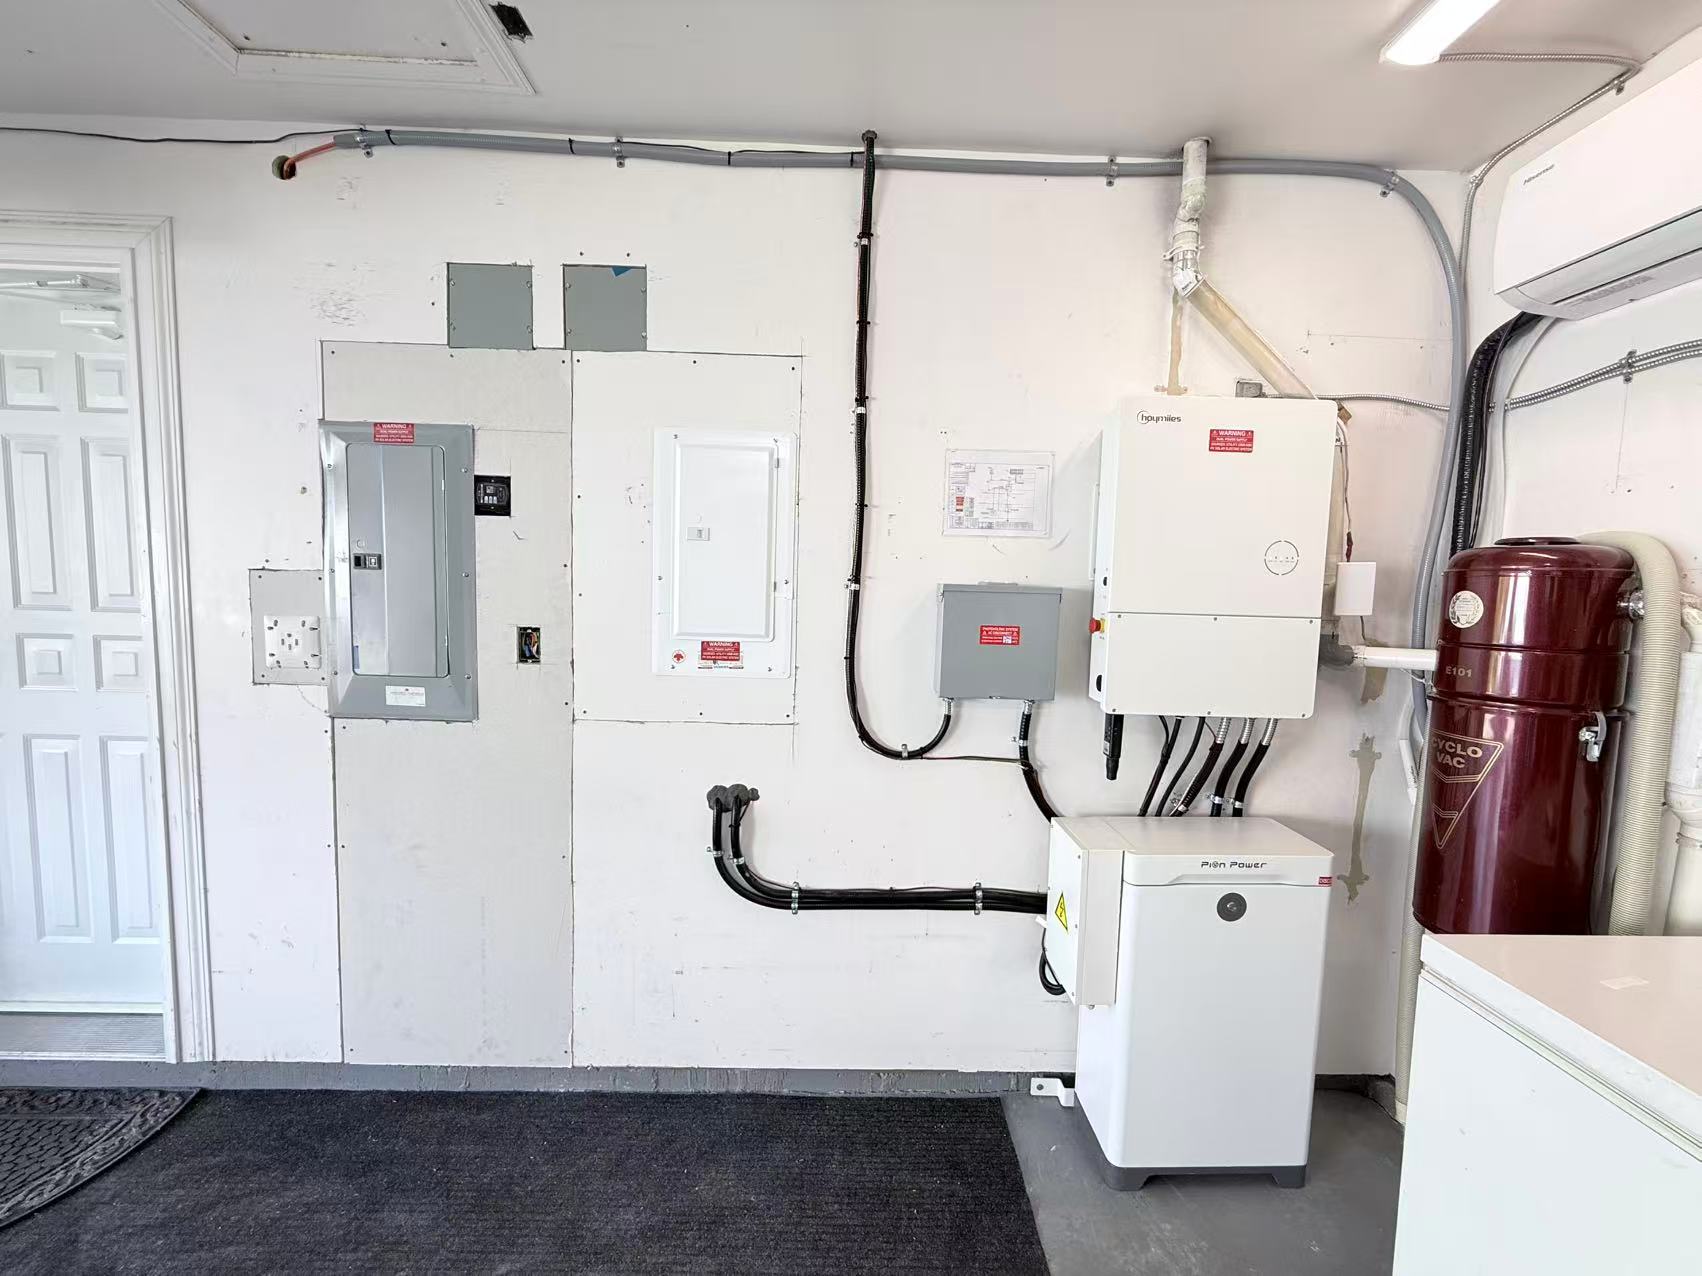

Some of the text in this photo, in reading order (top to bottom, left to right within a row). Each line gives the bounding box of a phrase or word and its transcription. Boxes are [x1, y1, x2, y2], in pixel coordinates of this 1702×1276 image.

[1141, 414, 1182, 424] hoymiles
[1446, 665, 1472, 678] E101
[1432, 737, 1482, 758] CYCLO
[1437, 752, 1466, 768] VAC
